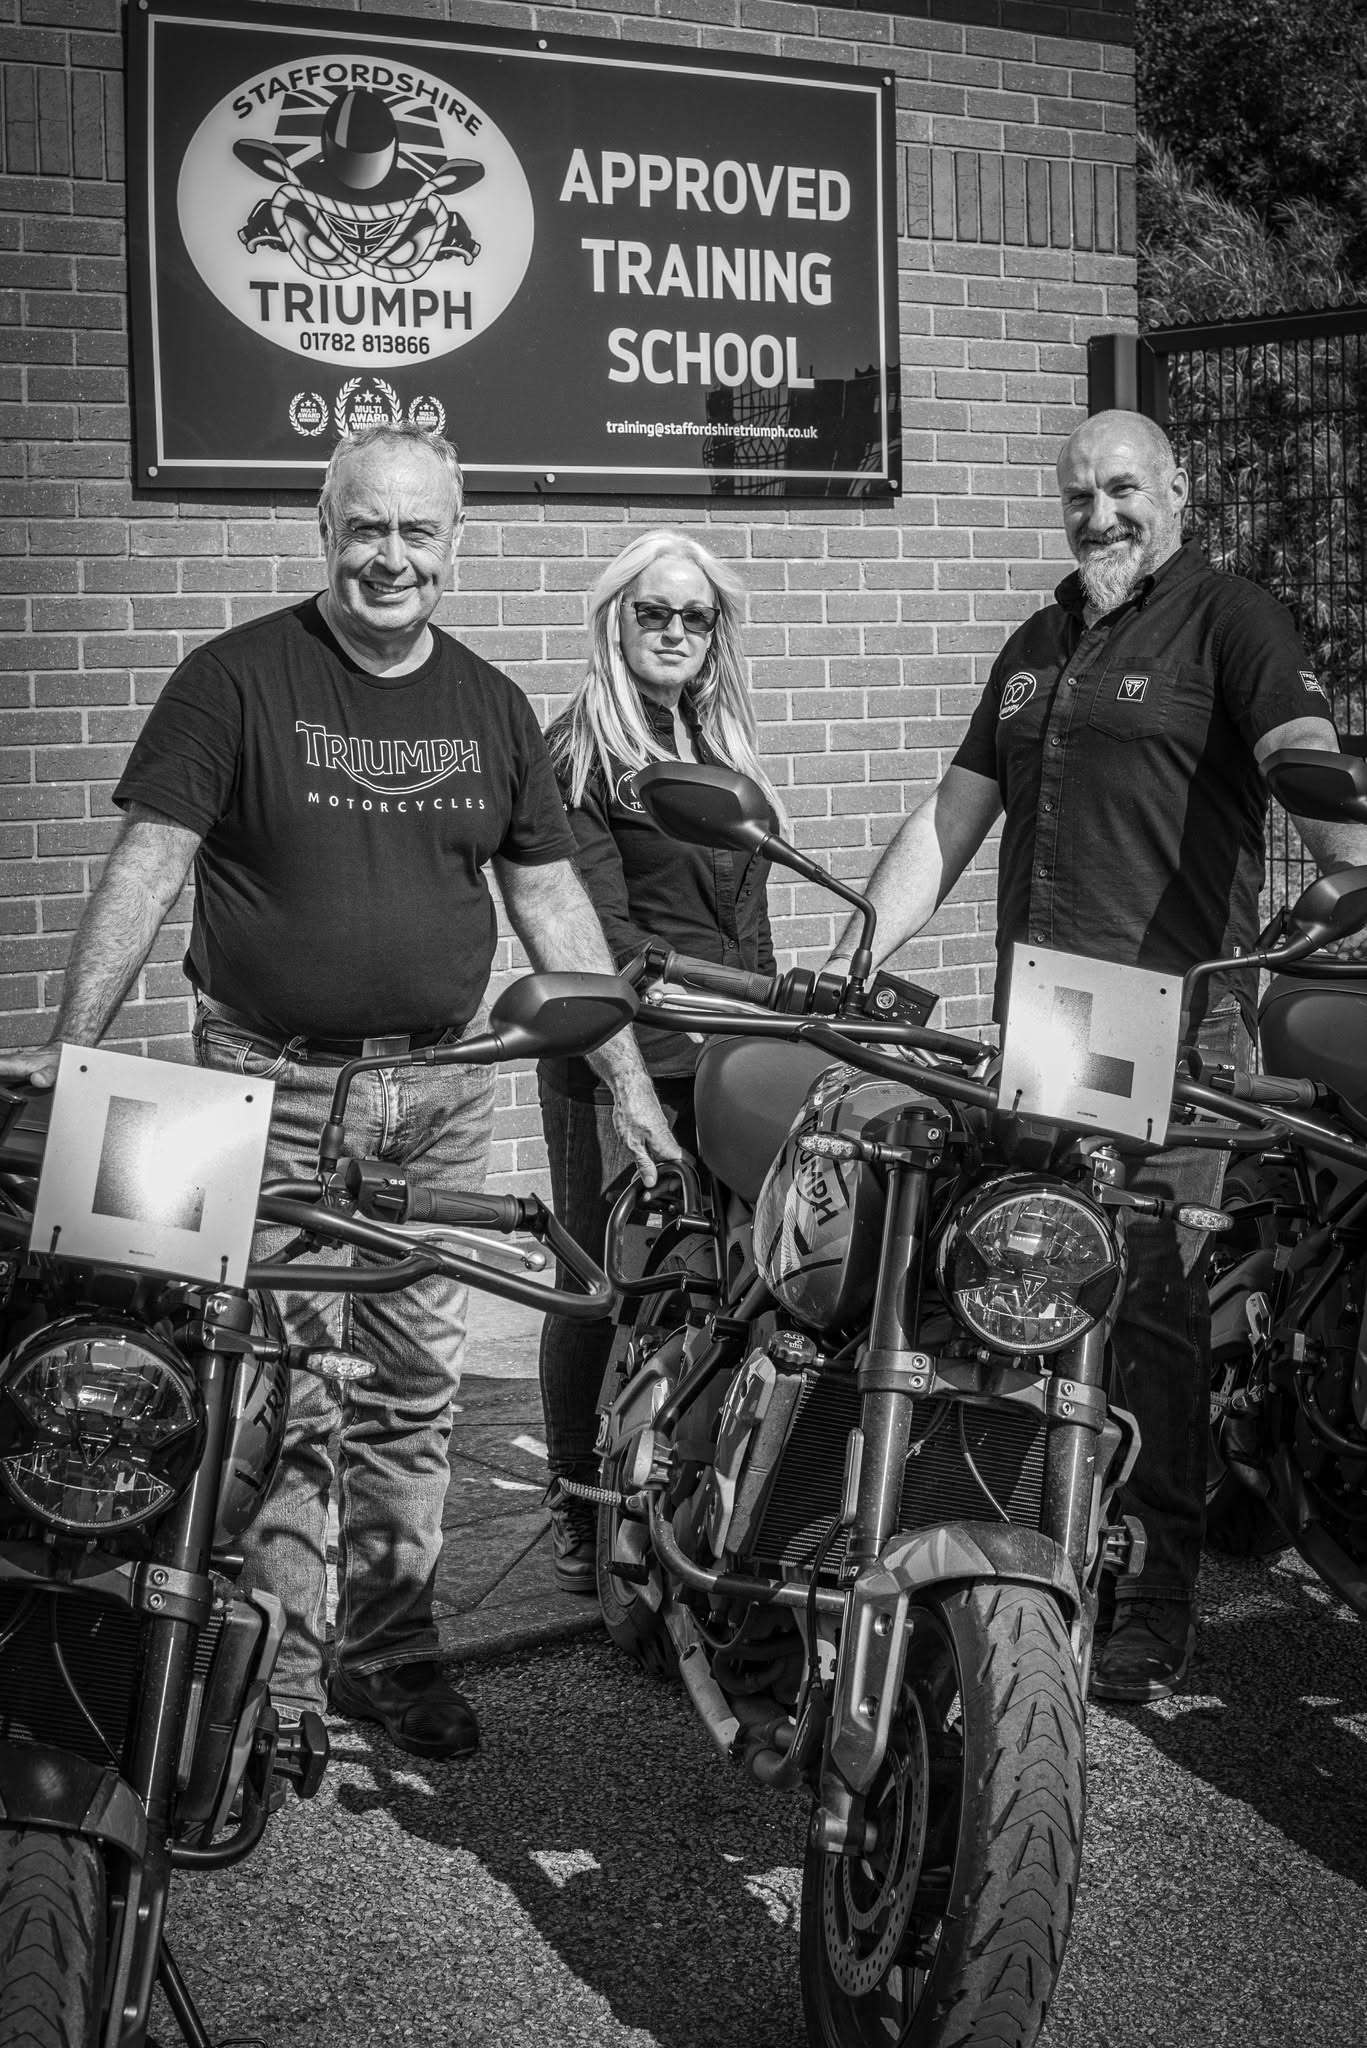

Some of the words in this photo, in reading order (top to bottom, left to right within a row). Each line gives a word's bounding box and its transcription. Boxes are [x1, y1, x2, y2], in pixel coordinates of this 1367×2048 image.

[232, 63, 483, 136] STAFFORDSHIRE
[559, 148, 851, 222] APPROVED
[581, 237, 832, 306] TRAINING
[249, 281, 473, 330] TRIUMPH
[300, 332, 355, 352] 01782
[362, 334, 430, 355] 813866
[607, 327, 815, 389] SCHOOL
[348, 412, 389, 423] AWARD
[354, 405, 383, 414] MULTI
[605, 420, 819, 440] training@staffordshiretriumph.co.uk
[296, 721, 482, 794] TRIUMPH
[307, 792, 486, 813] MOTORCYCLES
